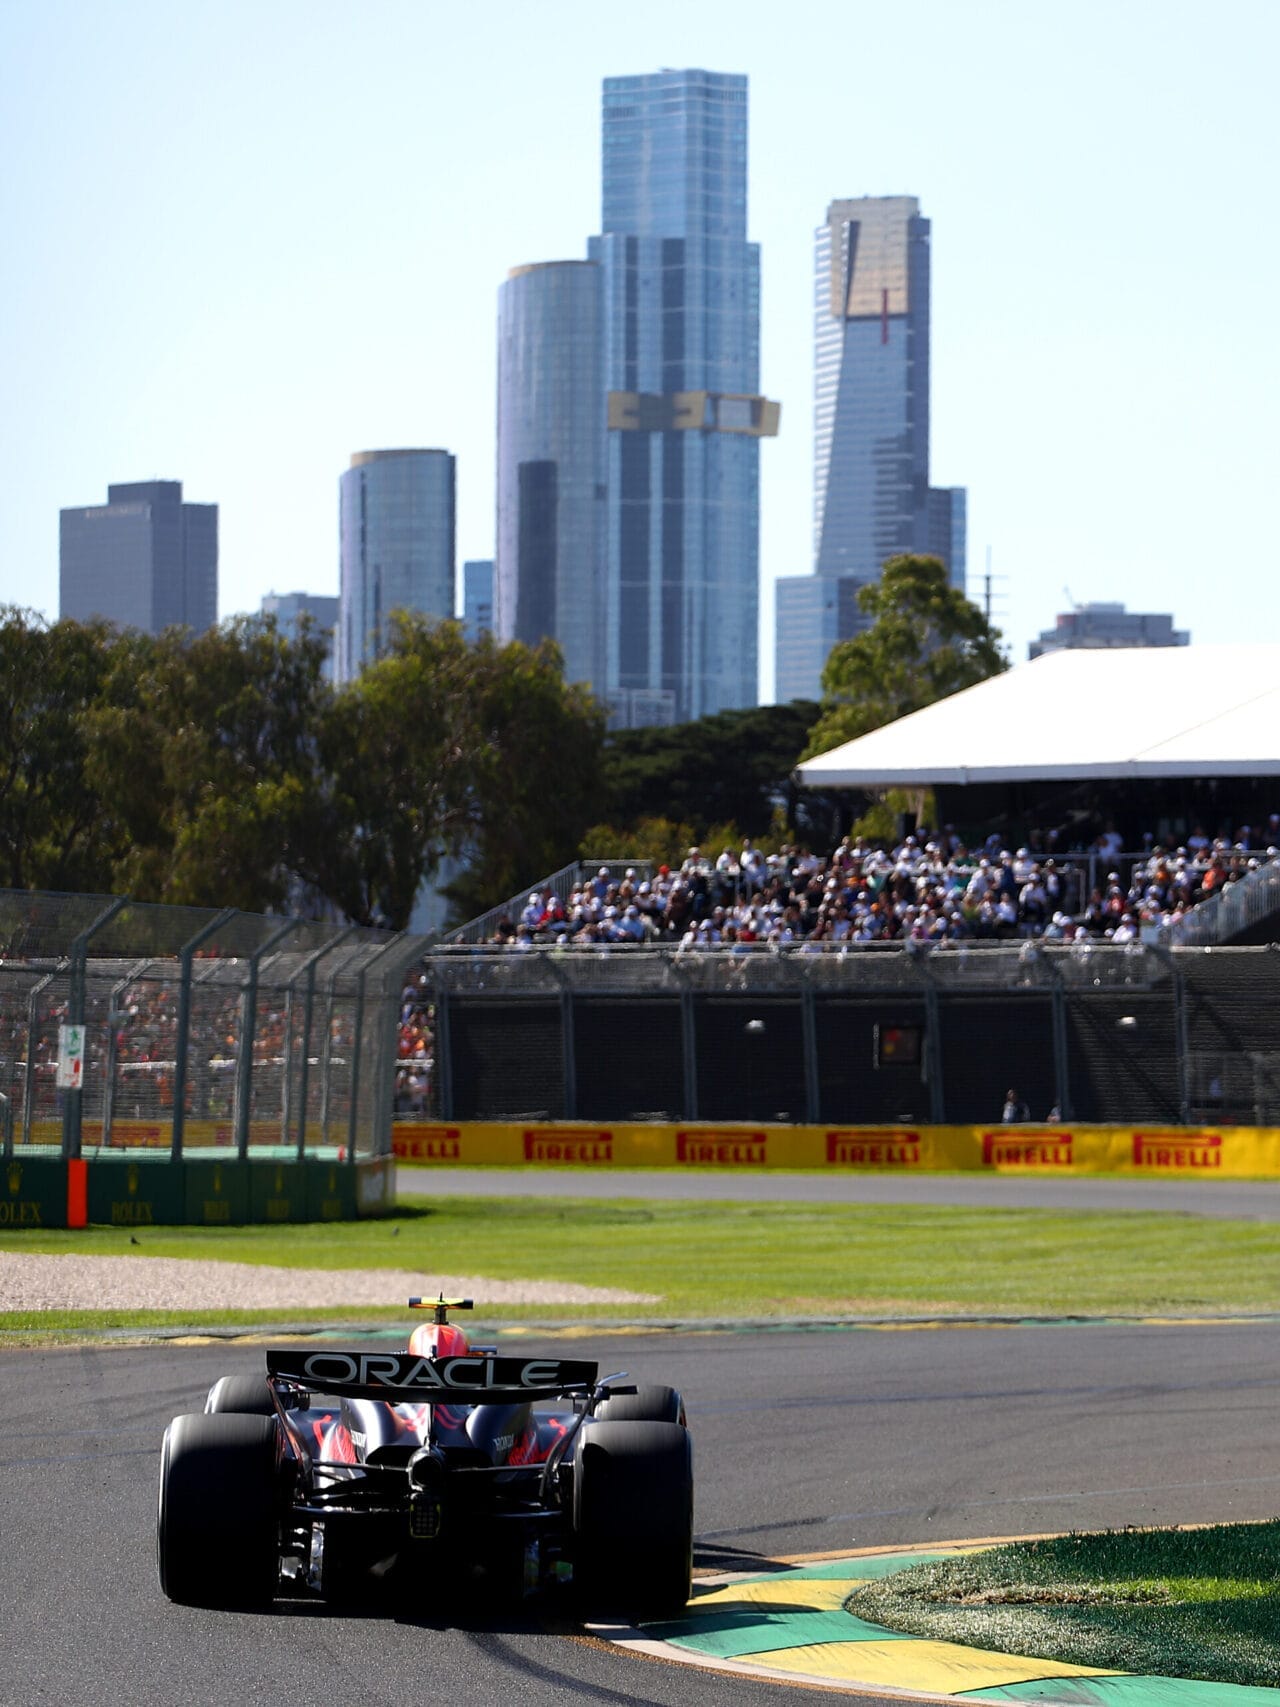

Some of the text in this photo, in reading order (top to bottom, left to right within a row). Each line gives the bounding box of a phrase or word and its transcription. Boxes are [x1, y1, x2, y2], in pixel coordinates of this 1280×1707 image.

[393, 1128, 460, 1159] RELLI
[524, 1130, 613, 1161] PIRELLI
[676, 1132, 766, 1163] PIRELLI
[826, 1133, 920, 1164] PIRELLI
[982, 1133, 1072, 1164] PIRELLI
[1133, 1134, 1222, 1167] PIRELLI
[0, 1202, 41, 1223] OLEX
[112, 1202, 153, 1223] ROLEX
[305, 1354, 561, 1388] ORACLE
